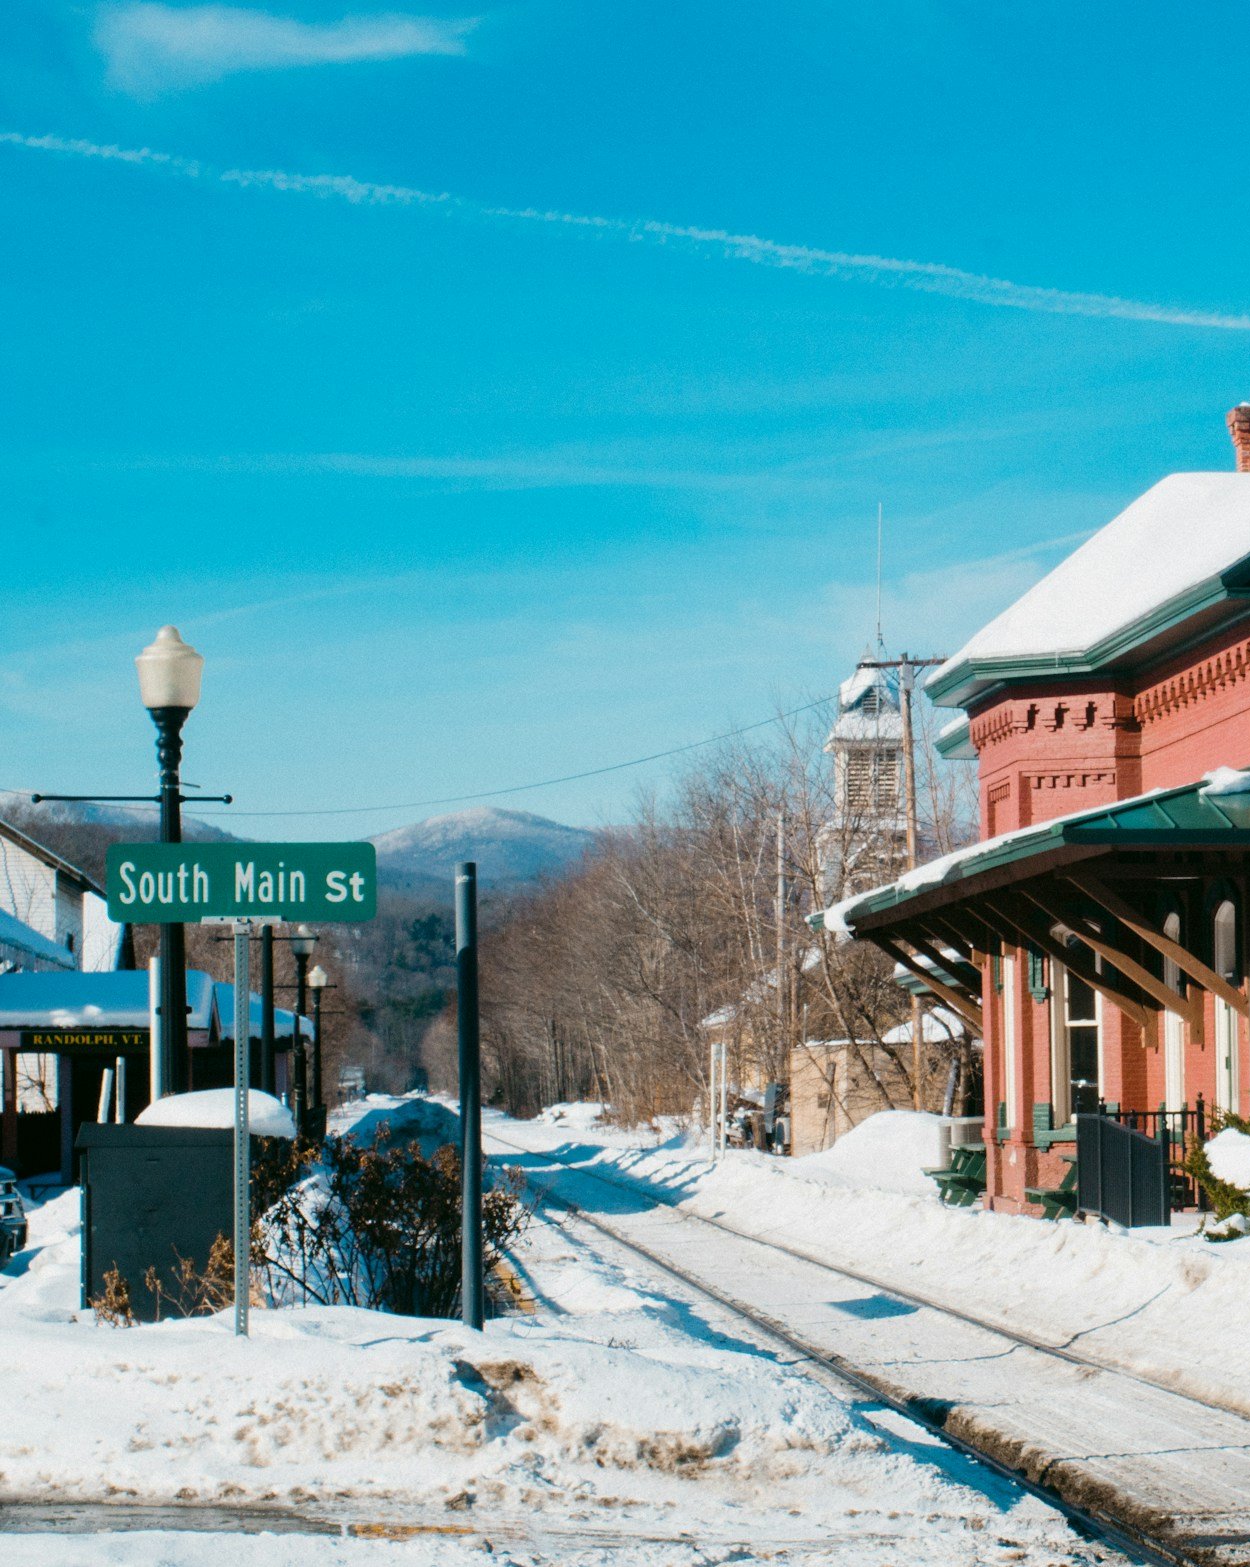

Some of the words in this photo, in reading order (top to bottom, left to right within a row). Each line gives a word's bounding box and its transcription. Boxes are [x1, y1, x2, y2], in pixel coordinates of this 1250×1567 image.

[119, 861, 209, 905] South
[235, 861, 306, 903] Main
[325, 870, 365, 903] St
[33, 1034, 118, 1045] RANDOLPH,
[122, 1034, 143, 1045] VT.
